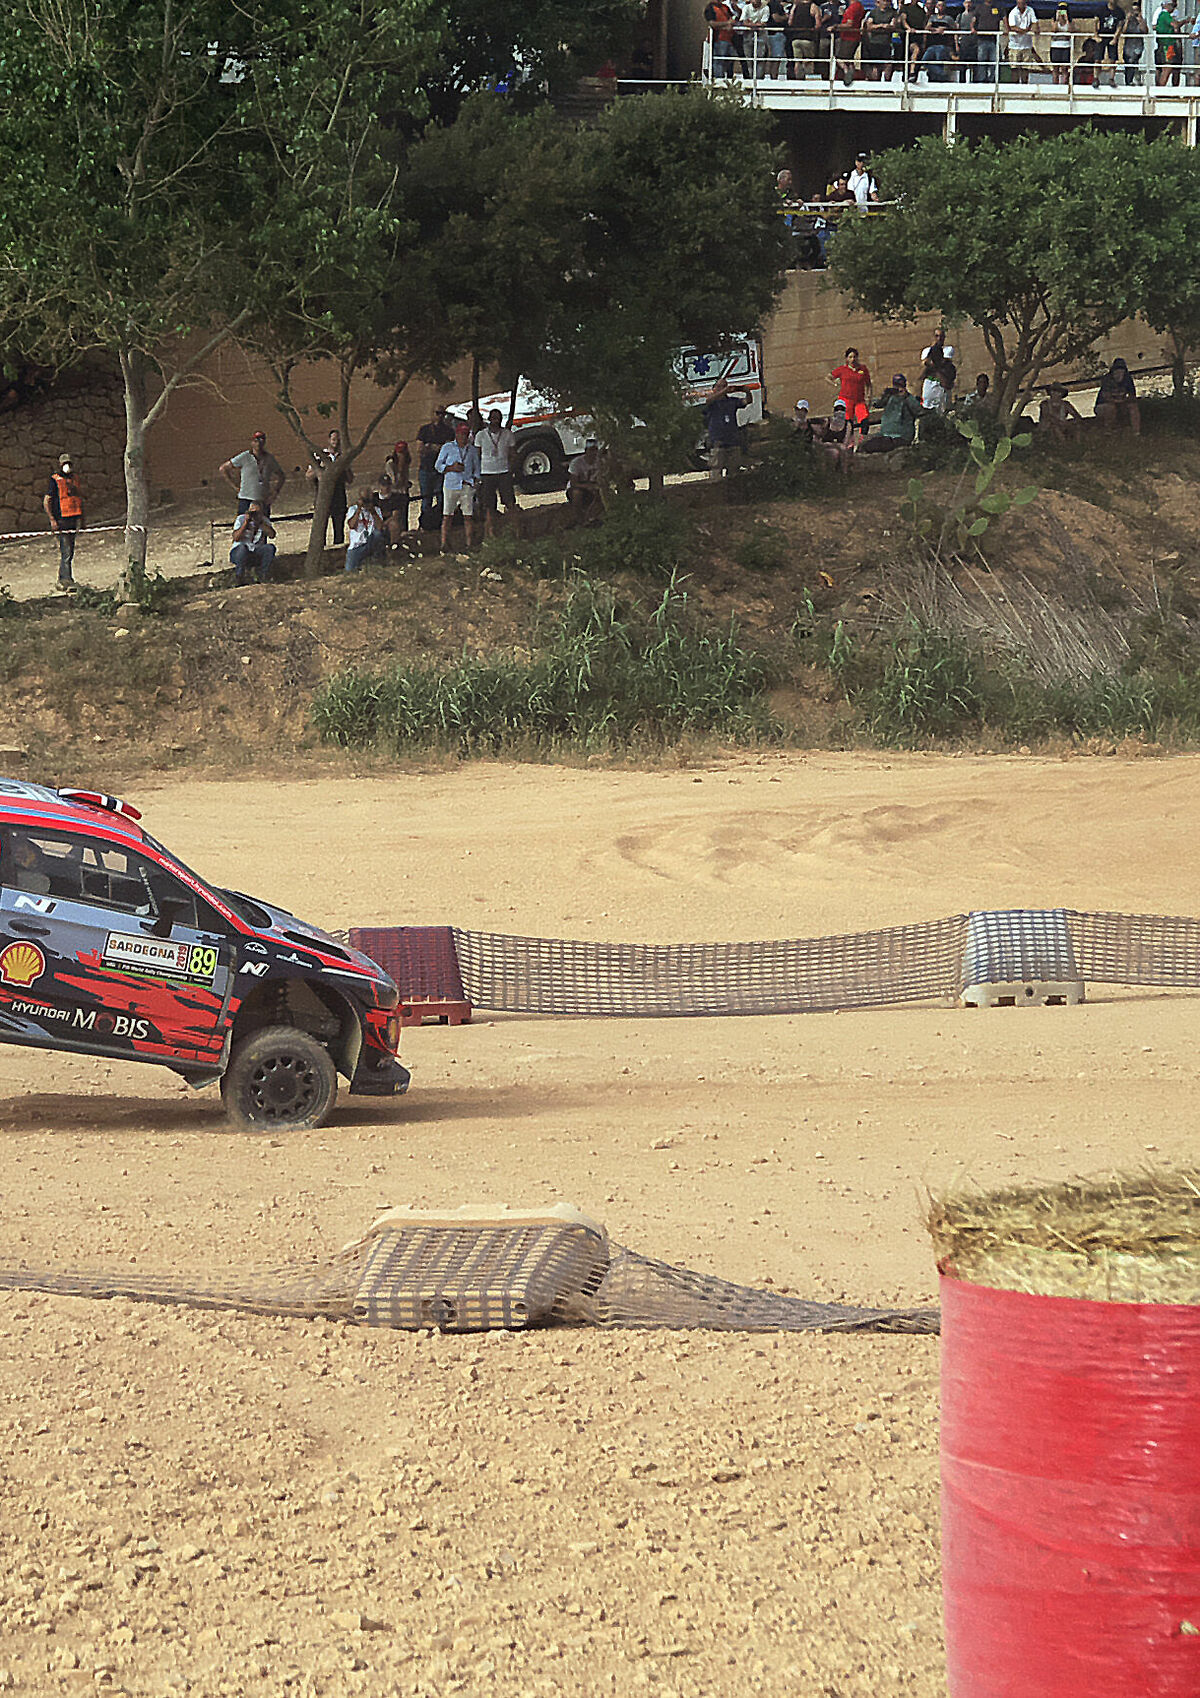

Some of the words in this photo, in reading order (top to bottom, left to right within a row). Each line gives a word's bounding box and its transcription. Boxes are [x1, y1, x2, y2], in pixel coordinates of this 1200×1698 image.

[108, 939, 175, 961] SARDEGNA
[175, 944, 189, 968] 2019
[189, 947, 216, 976] 89
[11, 1001, 71, 1022] HYUNDAI
[71, 1008, 150, 1039] MOBIS
